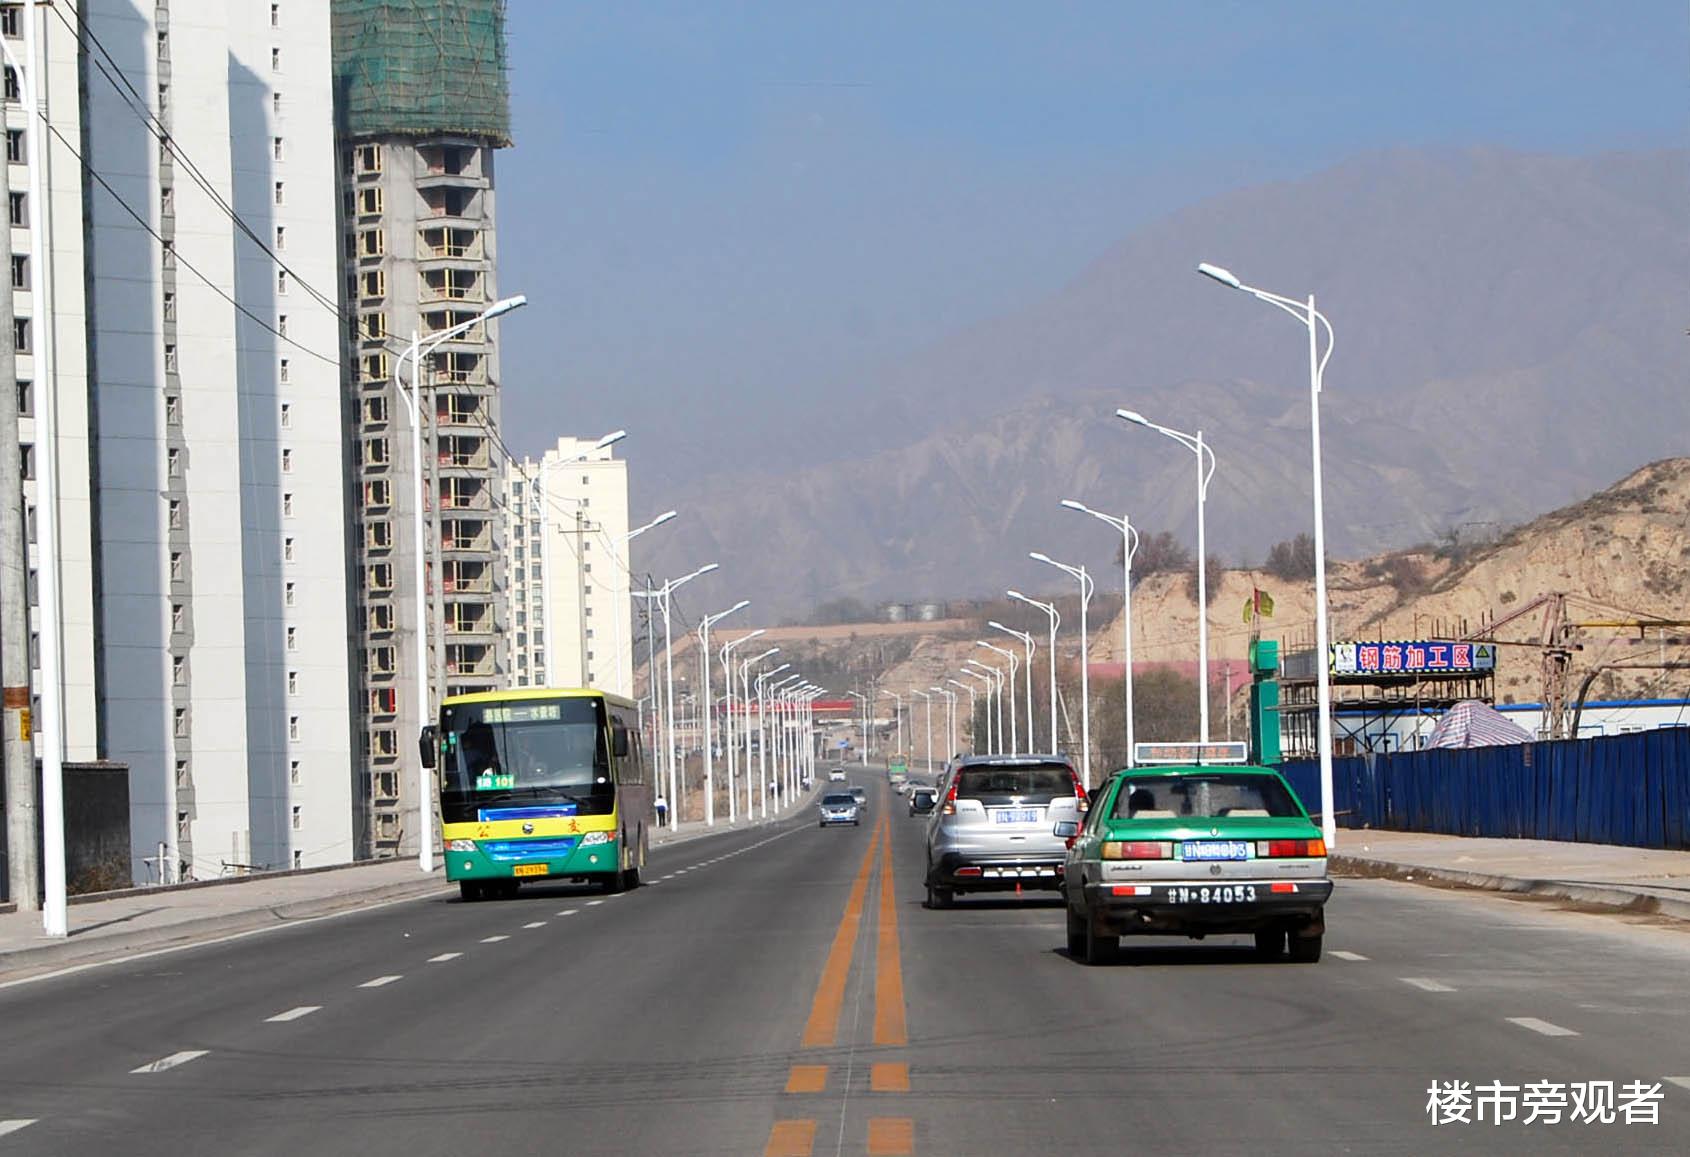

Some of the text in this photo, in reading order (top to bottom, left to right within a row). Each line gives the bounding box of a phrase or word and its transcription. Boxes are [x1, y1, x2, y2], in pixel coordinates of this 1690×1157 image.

[1359, 645, 1471, 669] 钢筋加工区
